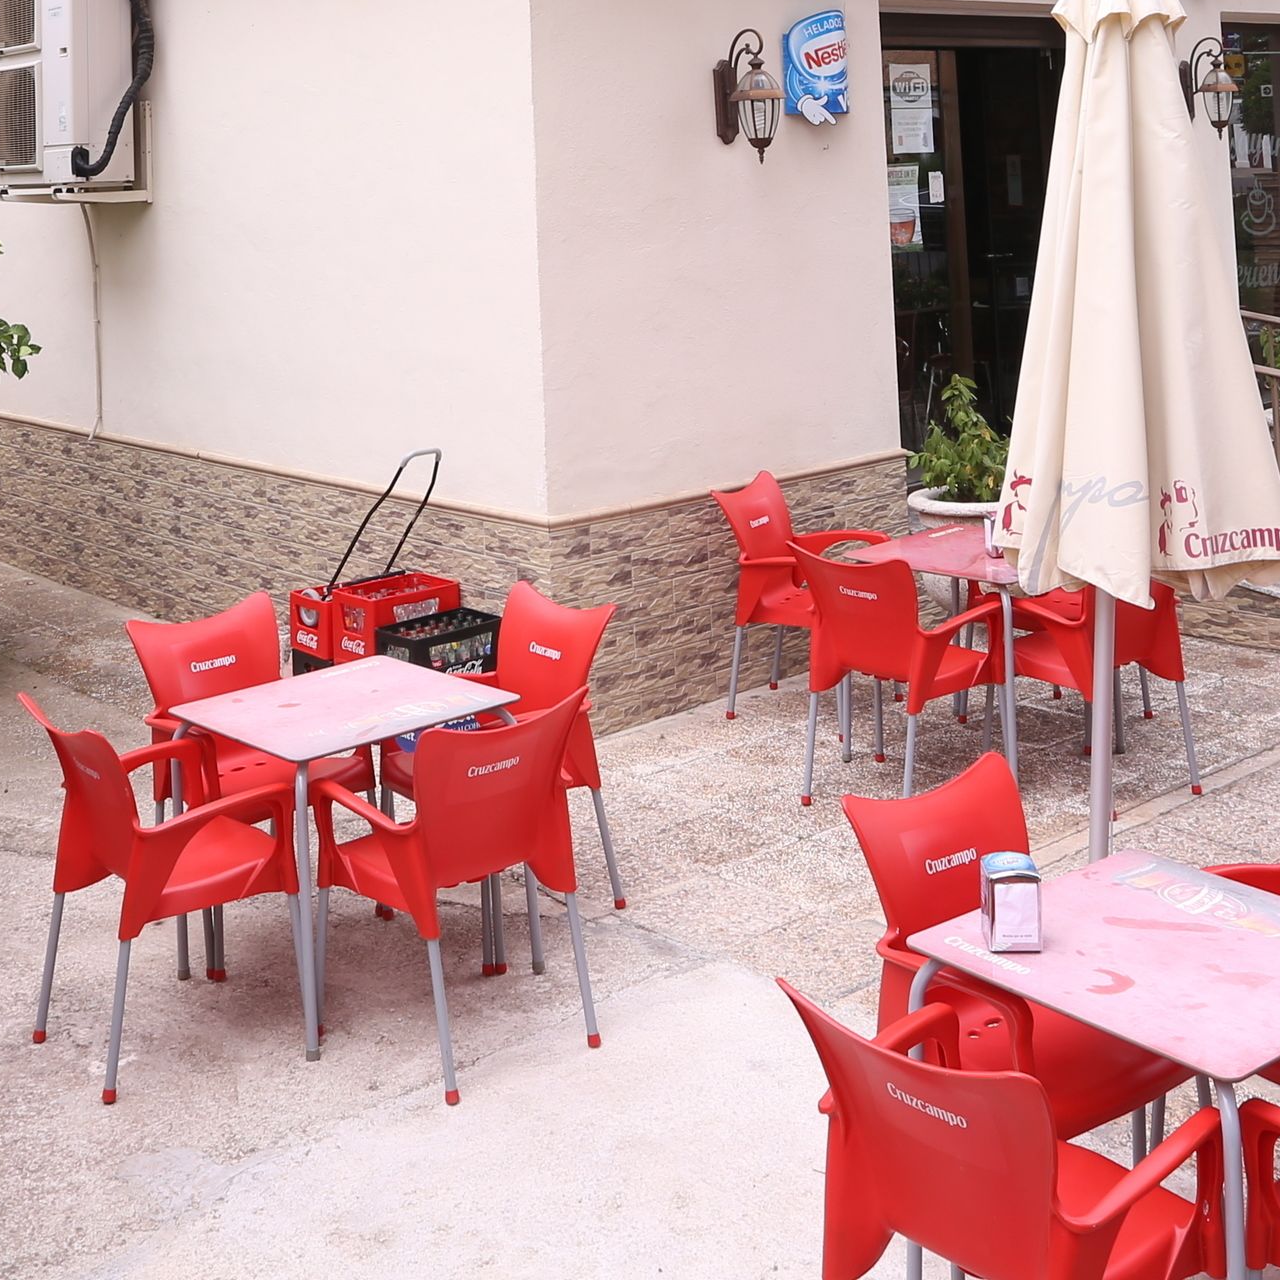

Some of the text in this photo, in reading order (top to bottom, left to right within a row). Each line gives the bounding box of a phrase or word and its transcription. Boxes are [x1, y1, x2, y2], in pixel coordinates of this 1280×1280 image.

[839, 585, 878, 601] Cruzcampo
[529, 641, 562, 661] Cruzcampo
[191, 654, 236, 673] Cruzcampo
[467, 755, 520, 778] Cruzcampo
[924, 847, 977, 875] Cruzcampo
[886, 1081, 968, 1129] Cruzcampo
